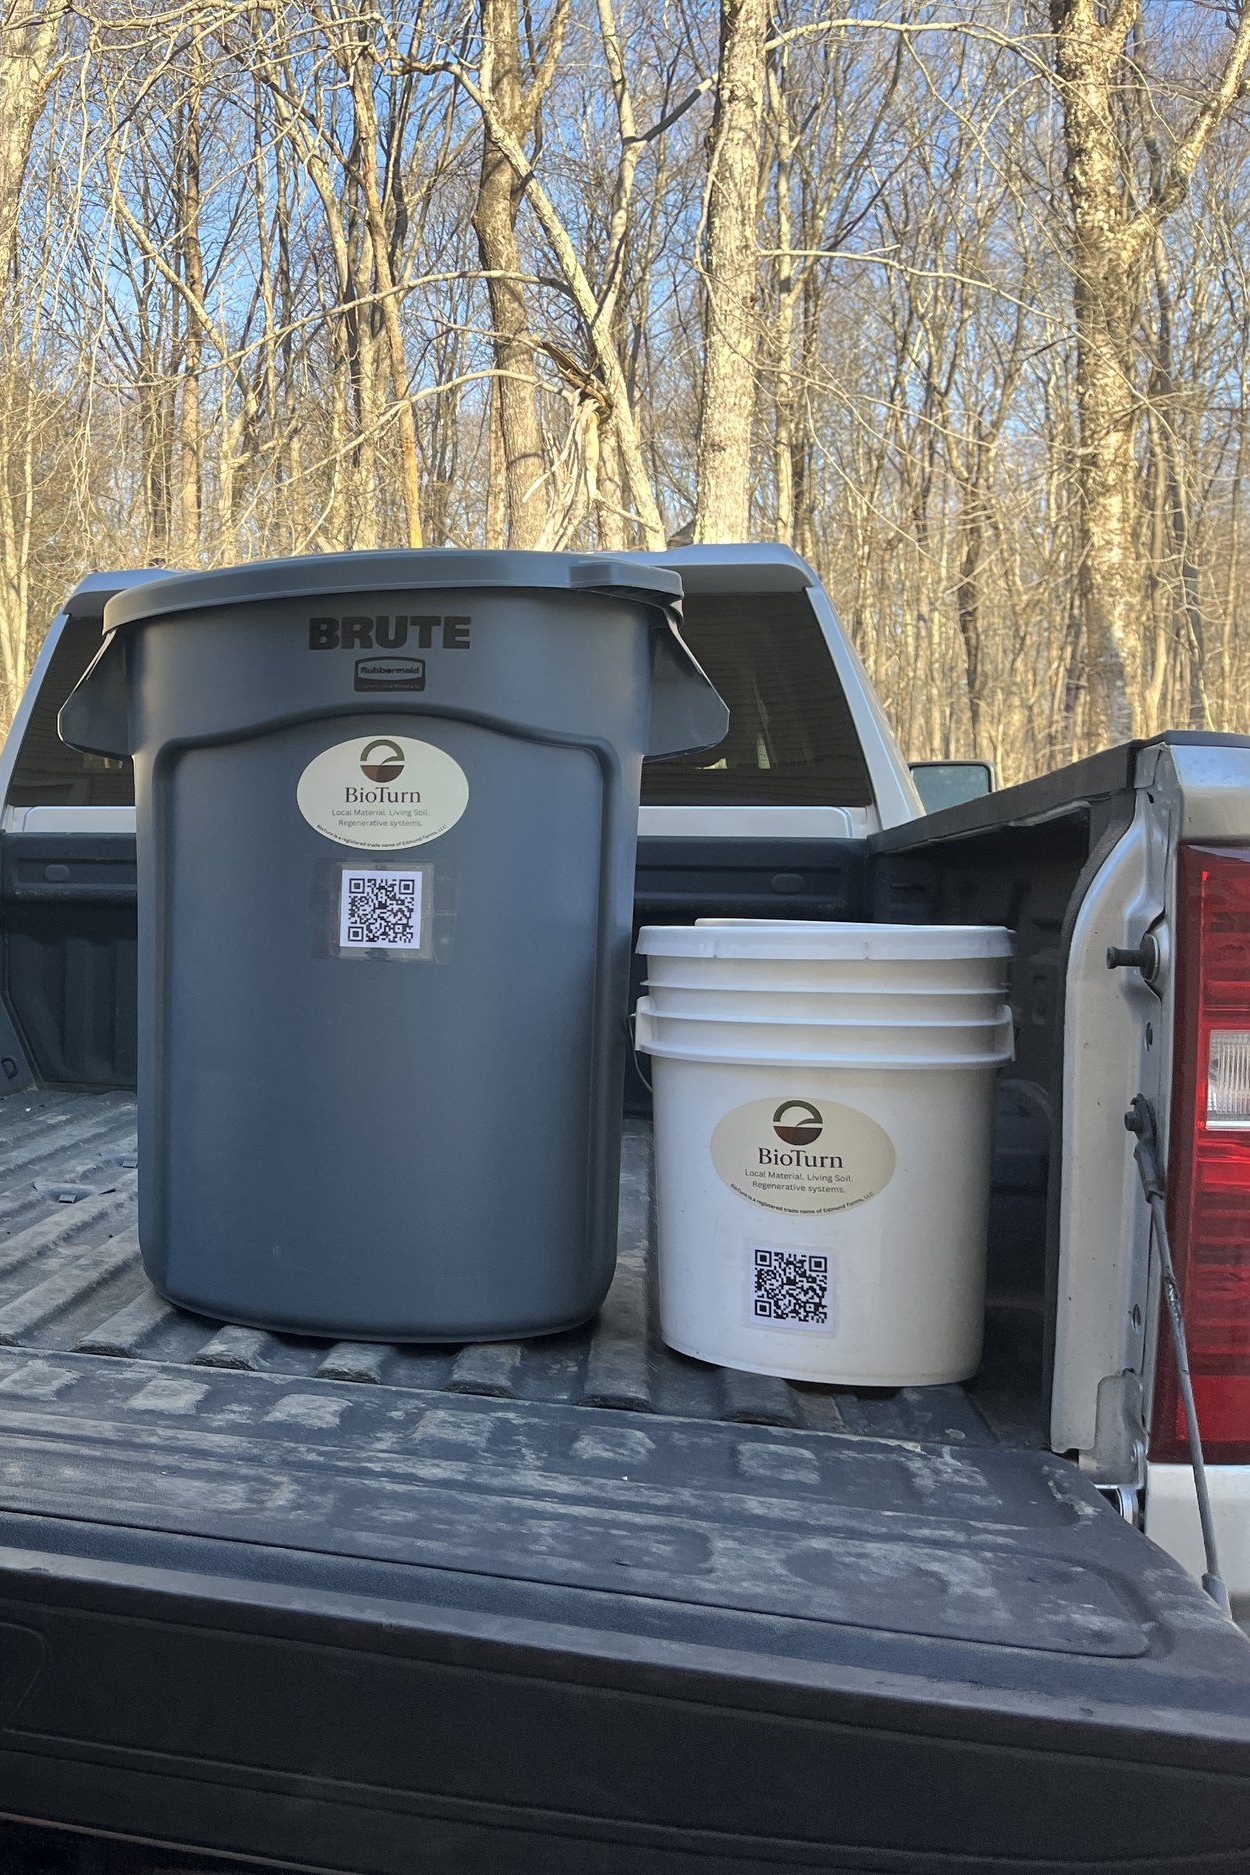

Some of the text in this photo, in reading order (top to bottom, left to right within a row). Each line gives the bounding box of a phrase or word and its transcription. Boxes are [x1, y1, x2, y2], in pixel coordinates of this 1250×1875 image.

[308, 615, 472, 650] BRUTE
[360, 665, 420, 675] Rubbermaid
[345, 786, 421, 804] BioTurn
[389, 809, 411, 818] Living
[338, 819, 423, 828] Regenerative systems.
[757, 1147, 844, 1168] BioTurn
[745, 1169, 853, 1184] Local Material. Living Soil.
[752, 1180, 846, 1194] Regenerative systems.
